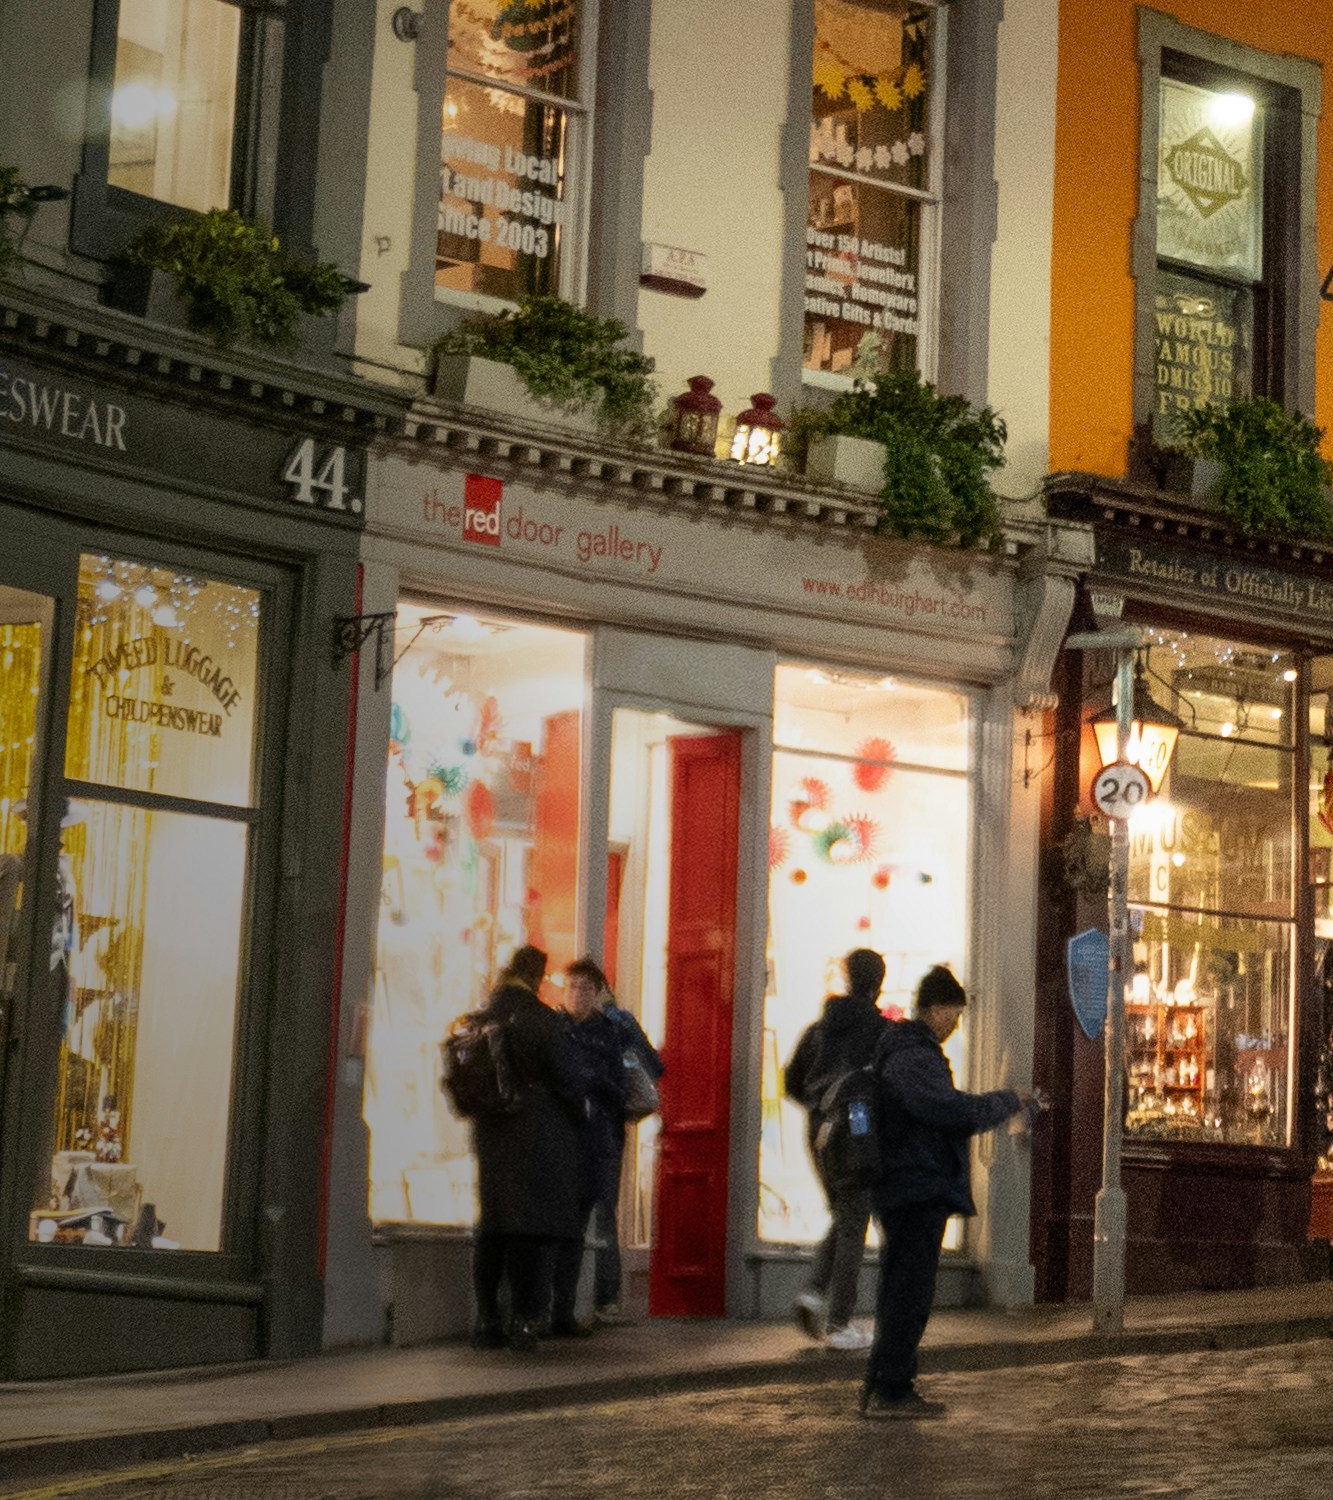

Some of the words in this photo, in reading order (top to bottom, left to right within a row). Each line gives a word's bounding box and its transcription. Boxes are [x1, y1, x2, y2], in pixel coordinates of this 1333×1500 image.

[504, 145, 558, 186] Local
[1174, 151, 1239, 194] ORIGINAL
[495, 216, 549, 259] 2003
[1156, 312, 1235, 348] WORLD
[1156, 337, 1234, 374] AMOUS
[1156, 363, 1232, 398] DMISSIO
[421, 487, 462, 529] the
[463, 499, 501, 537] red
[507, 513, 563, 549] door
[577, 526, 664, 573] gallery
[801, 574, 987, 622] www.edinburghart.com
[1129, 548, 1195, 584] Retailer
[1200, 565, 1218, 588] of
[1223, 569, 1302, 610] Officially
[86, 635, 158, 690] TWEED
[163, 638, 242, 717] LUGGAGE
[160, 674, 175, 698] &
[104, 693, 224, 739] CHILDRENSWEAR
[1100, 776, 1144, 805] 20
